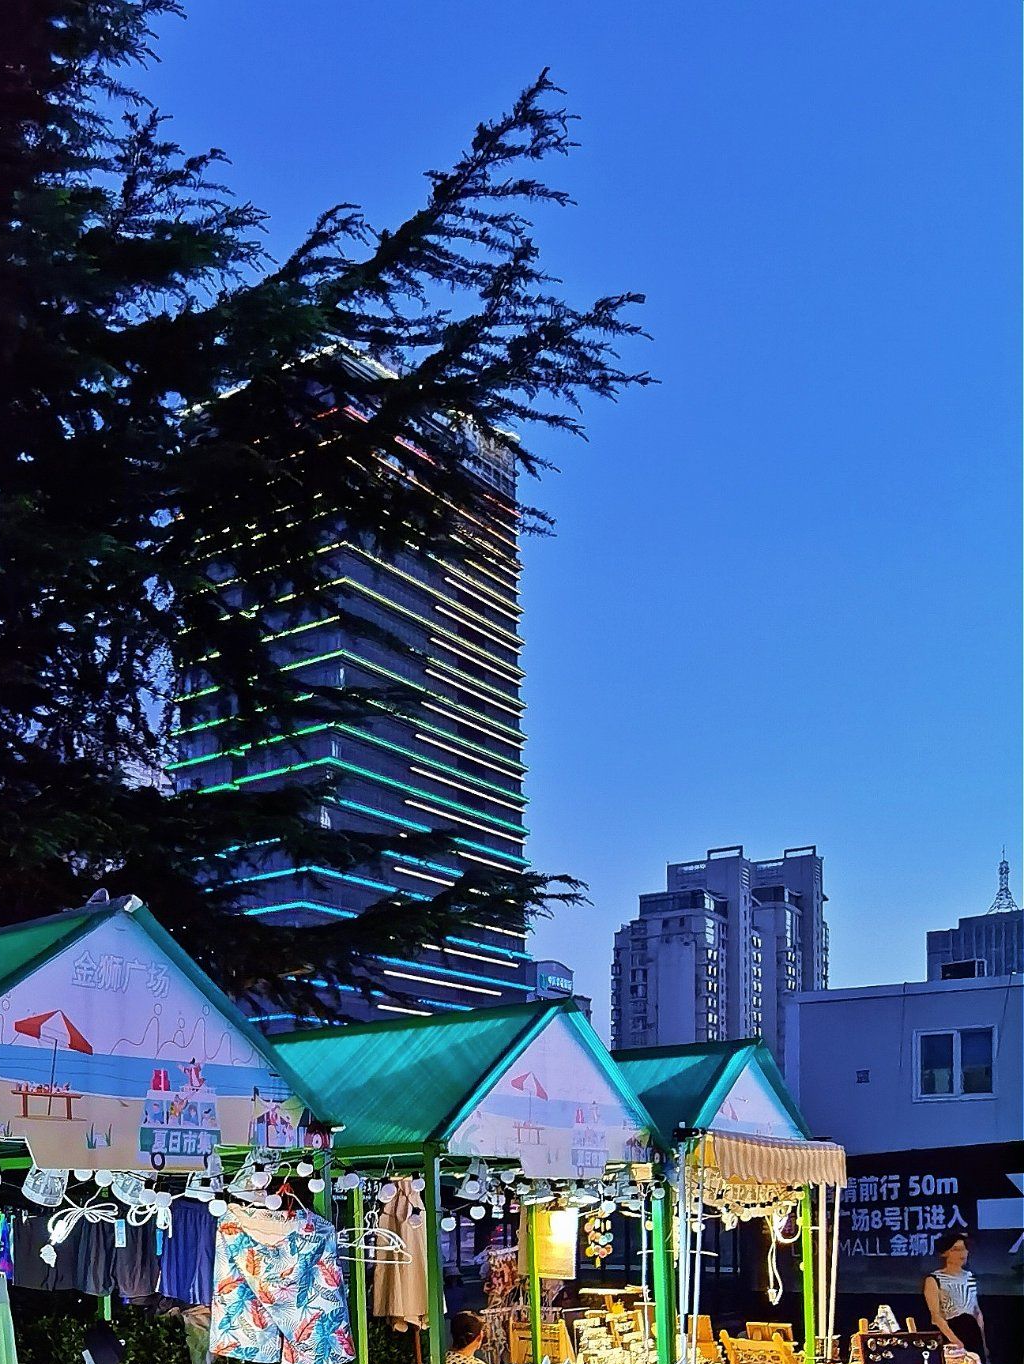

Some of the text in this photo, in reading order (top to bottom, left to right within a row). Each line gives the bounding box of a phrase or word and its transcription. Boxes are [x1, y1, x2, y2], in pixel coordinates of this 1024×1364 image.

[72, 949, 170, 999] 金狮广场
[909, 1175, 958, 1197] 50m
